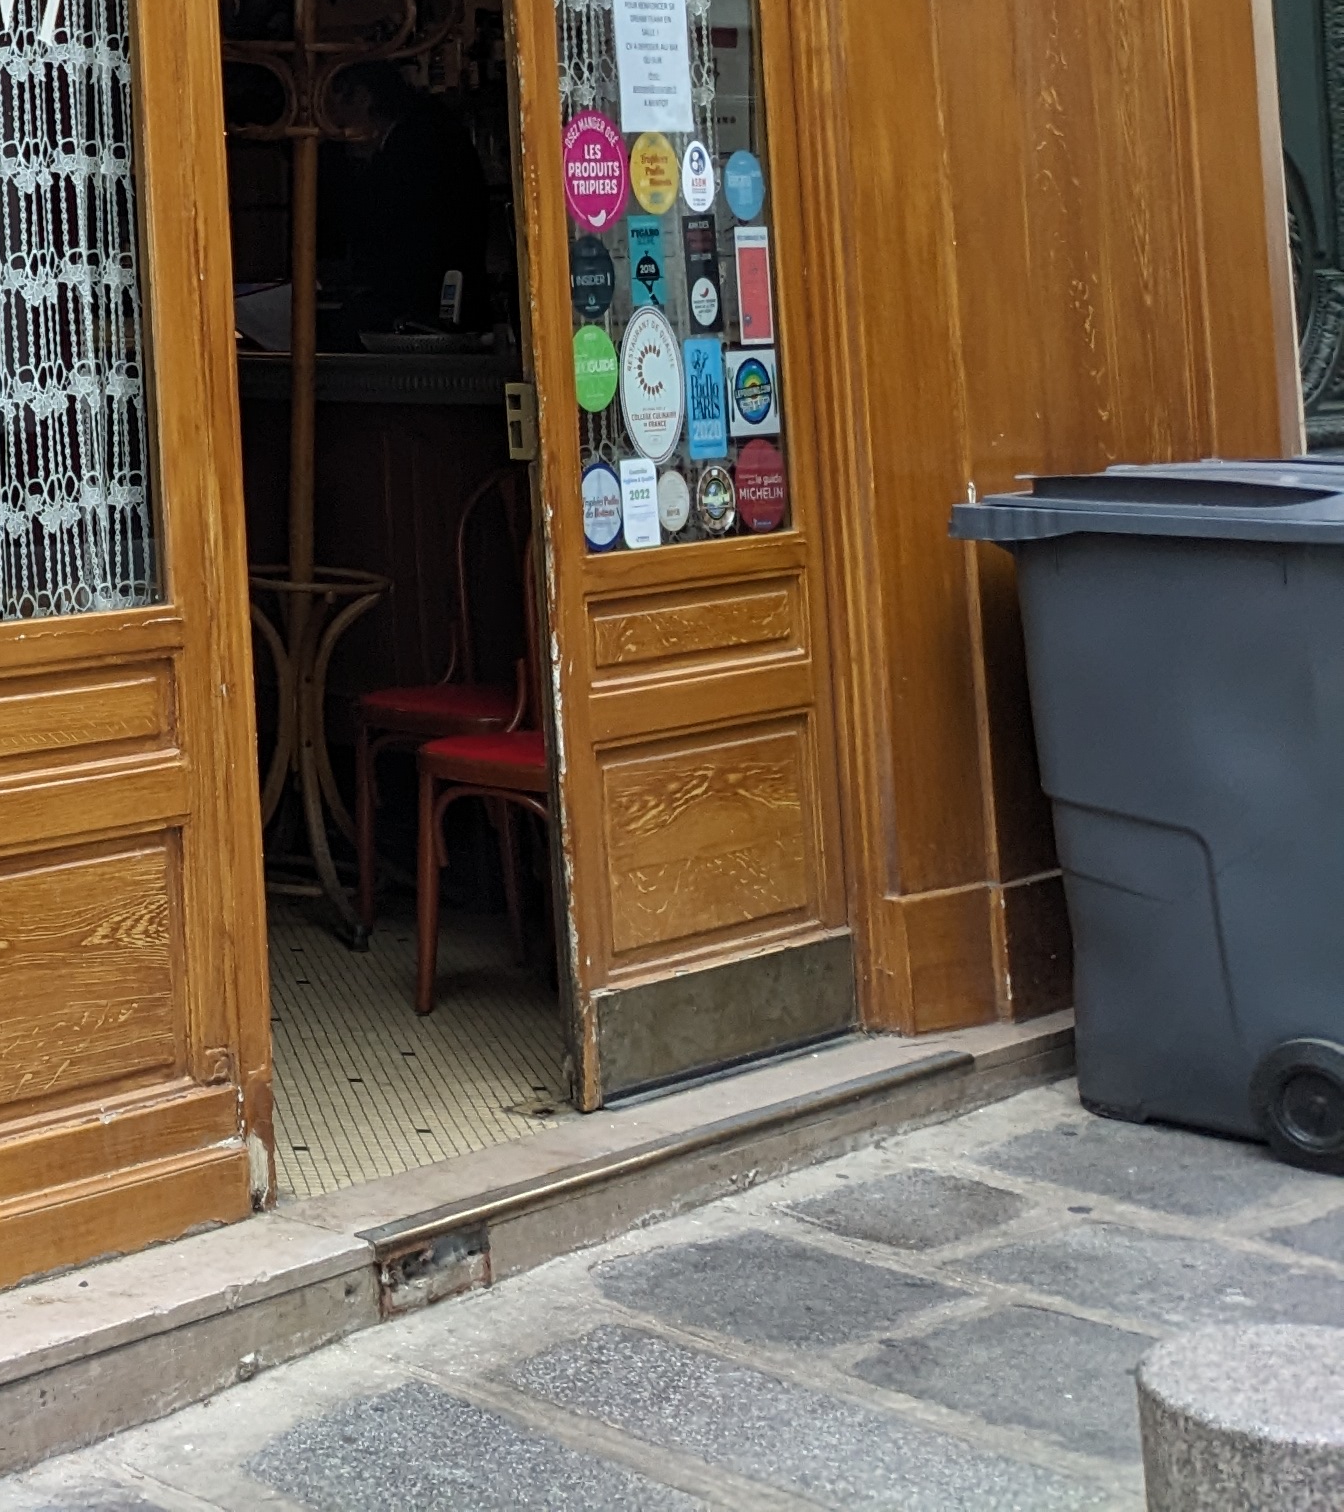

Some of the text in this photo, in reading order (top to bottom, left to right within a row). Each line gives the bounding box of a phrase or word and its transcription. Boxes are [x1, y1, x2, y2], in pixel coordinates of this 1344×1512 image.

[564, 124, 580, 149] OSEZ
[577, 116, 606, 135] MANGER
[584, 144, 602, 159] LES
[568, 161, 620, 177] PRODUITS
[572, 179, 618, 195] TRIPIERS
[693, 420, 722, 440] 2020
[629, 488, 651, 500] 2022
[739, 487, 784, 500] MICHELIN
